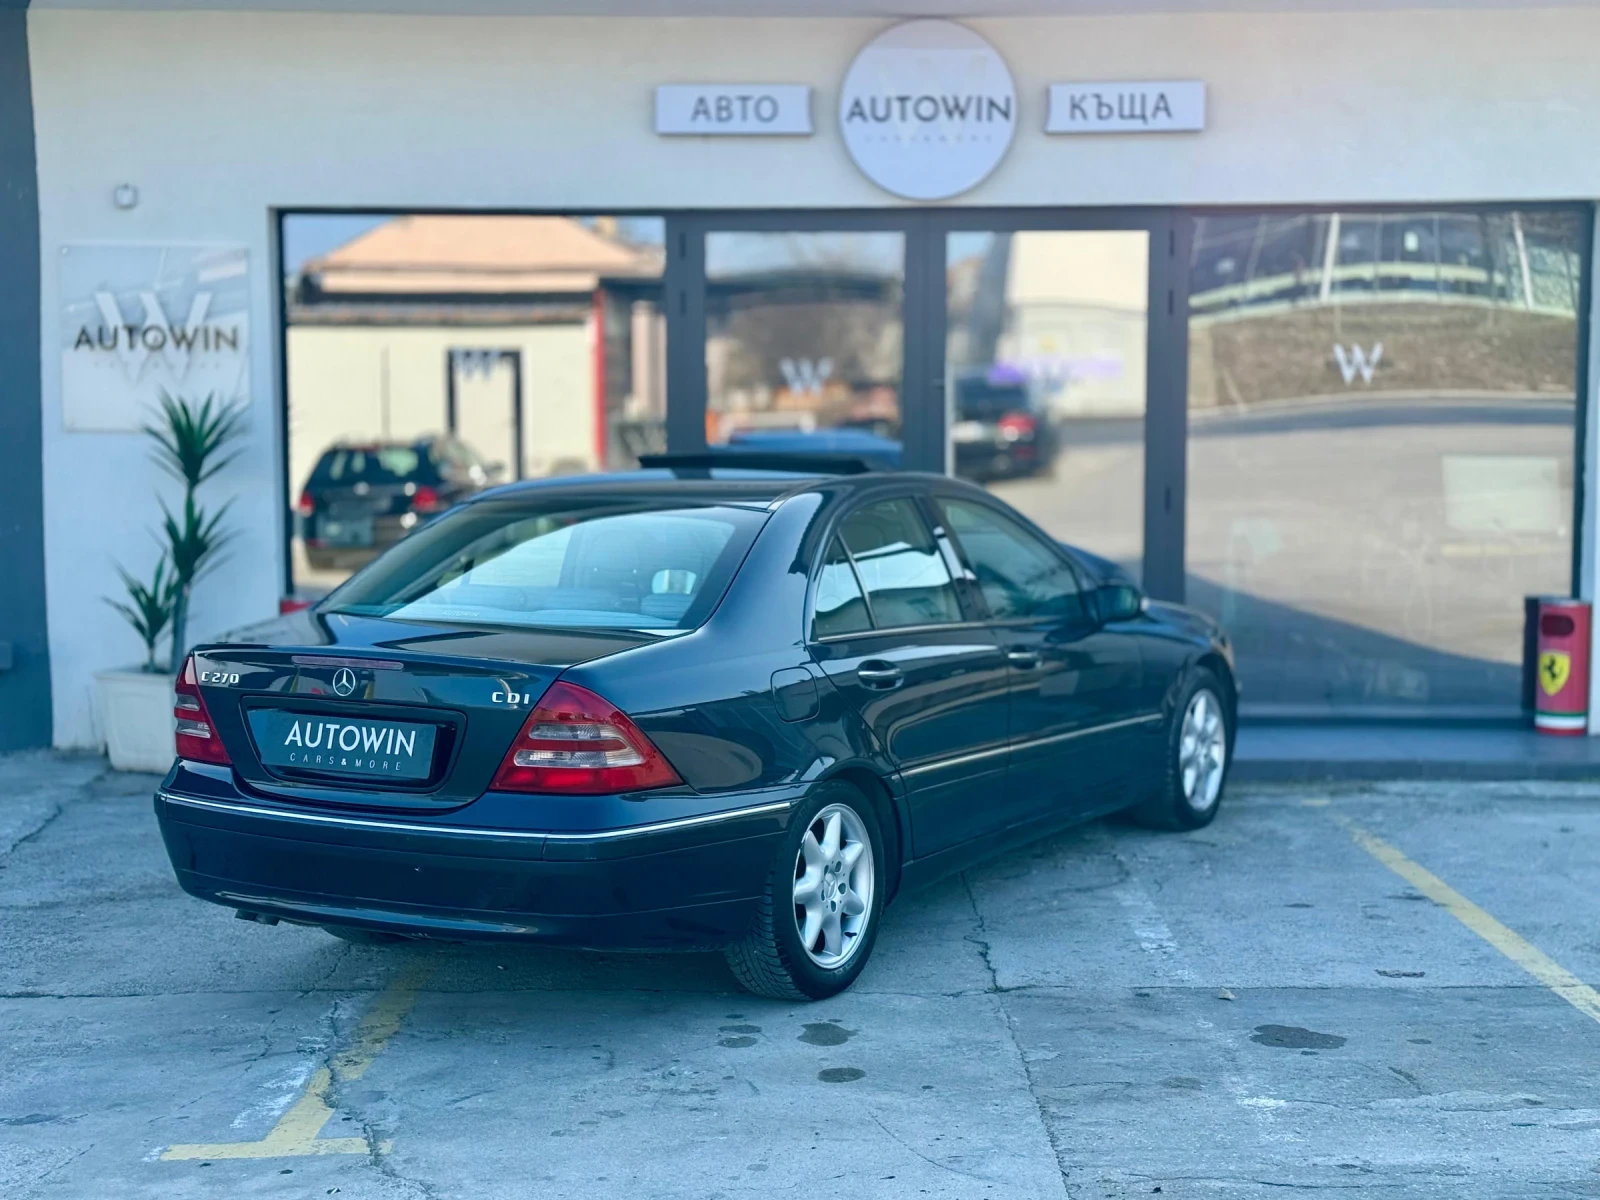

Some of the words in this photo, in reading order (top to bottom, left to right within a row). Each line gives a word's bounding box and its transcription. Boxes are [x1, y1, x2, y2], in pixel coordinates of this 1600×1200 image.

[691, 95, 780, 122] АВТО
[847, 95, 1012, 124] AUTOWIN
[1069, 92, 1174, 124] КЪЩА
[73, 325, 239, 354] AUTOWIN
[1332, 341, 1384, 386] W
[201, 671, 210, 682] C
[211, 672, 240, 684] 270
[491, 691, 530, 705] CDI
[284, 720, 417, 758] AUTOWIN
